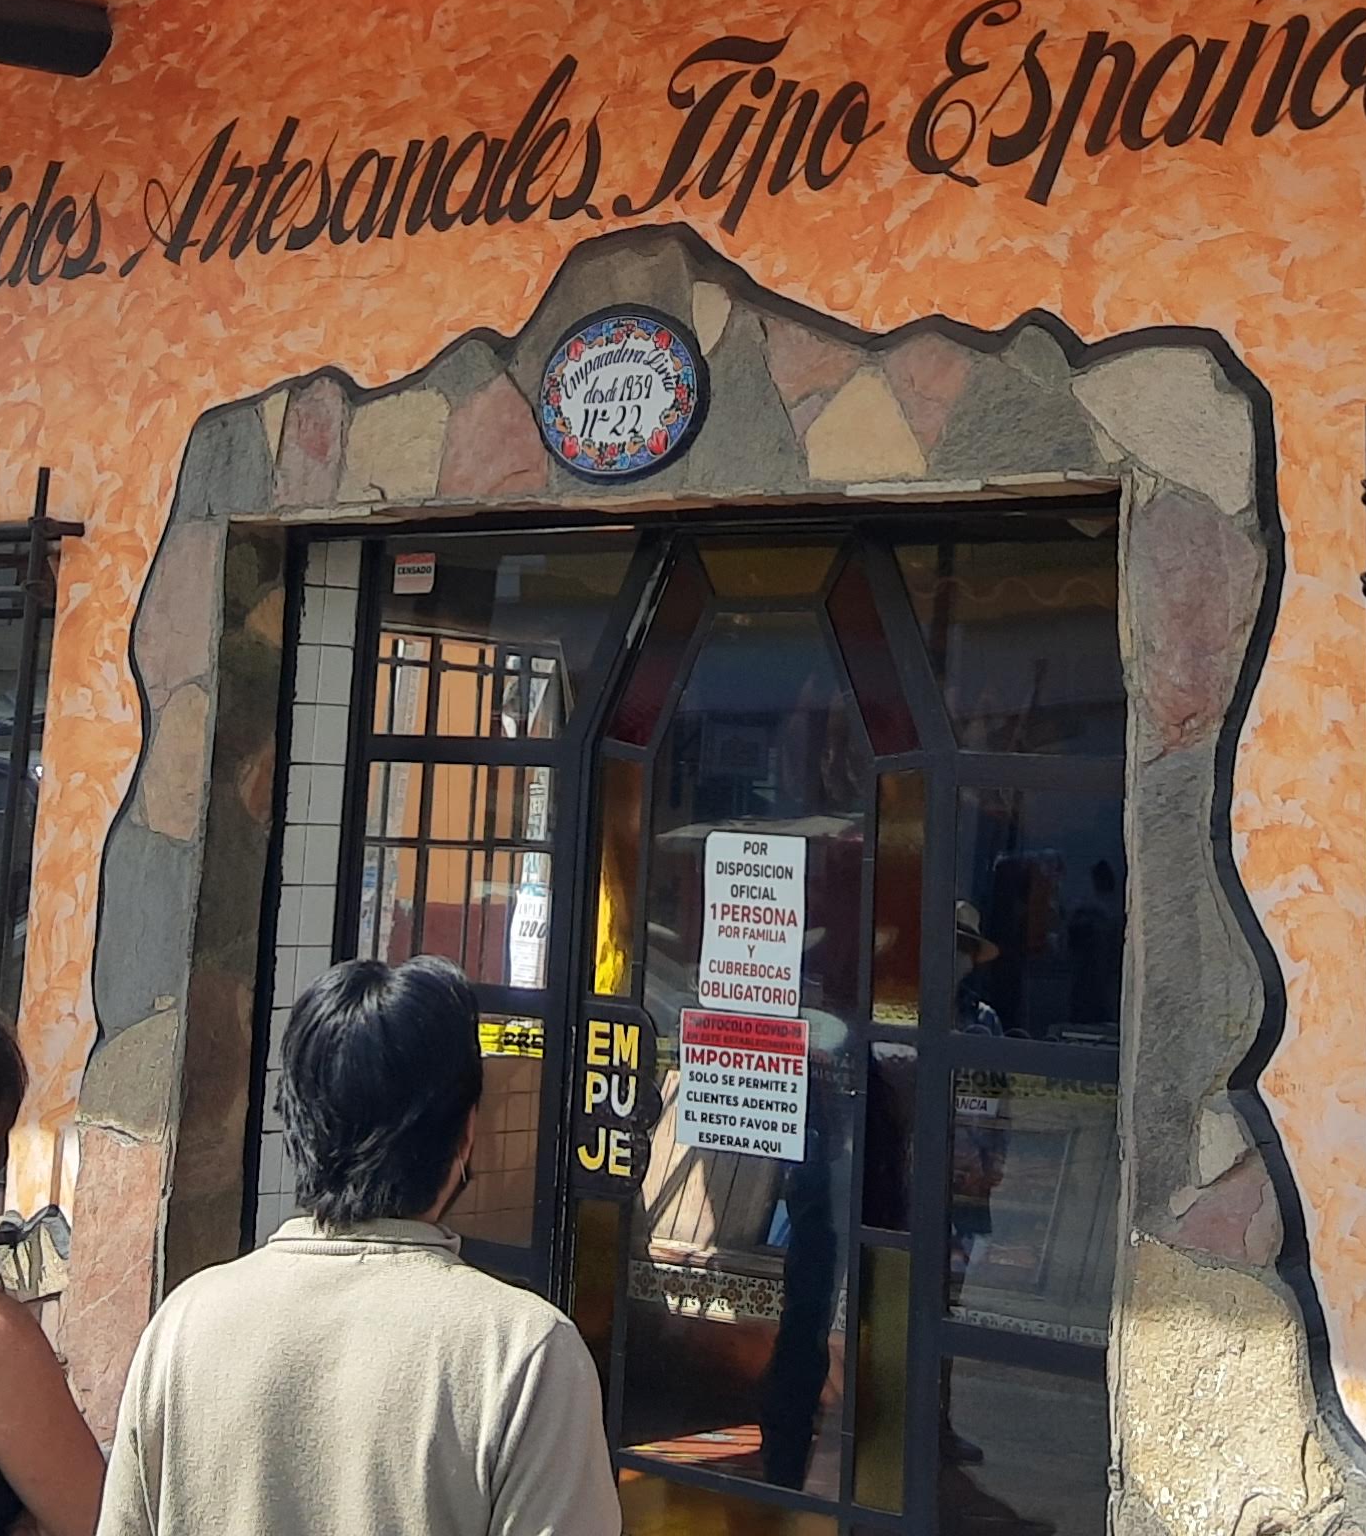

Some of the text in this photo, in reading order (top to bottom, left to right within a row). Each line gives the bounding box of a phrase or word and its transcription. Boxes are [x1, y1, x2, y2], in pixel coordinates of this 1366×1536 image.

[119, 54, 608, 277] Artesanales
[613, 35, 885, 236] Tipo
[583, 374, 653, 405] desde 1939
[610, 405, 644, 437] 22
[398, 566, 432, 575] CENSADO
[743, 841, 768, 856] POR
[716, 861, 794, 880] DISPOSICION
[730, 884, 777, 901] OFICIAL
[710, 903, 798, 927] 1 PERSONA
[718, 925, 786, 943] POR FAMILIA
[747, 945, 755, 958] Y
[708, 959, 791, 981] CUBREBOCAS
[701, 980, 797, 1006] OBLIGATORIO
[587, 1020, 640, 1070] EM
[685, 1047, 804, 1076] IMPORTANTE
[585, 1071, 637, 1117] PU
[688, 1071, 798, 1094] SOLO SE PERMITE 2
[686, 1090, 798, 1114] CLIENTES ADENTRO
[685, 1110, 797, 1135] EL RESTO FAVOR DE
[577, 1127, 632, 1177] JE
[698, 1131, 781, 1153] ESPERAR AQUI
